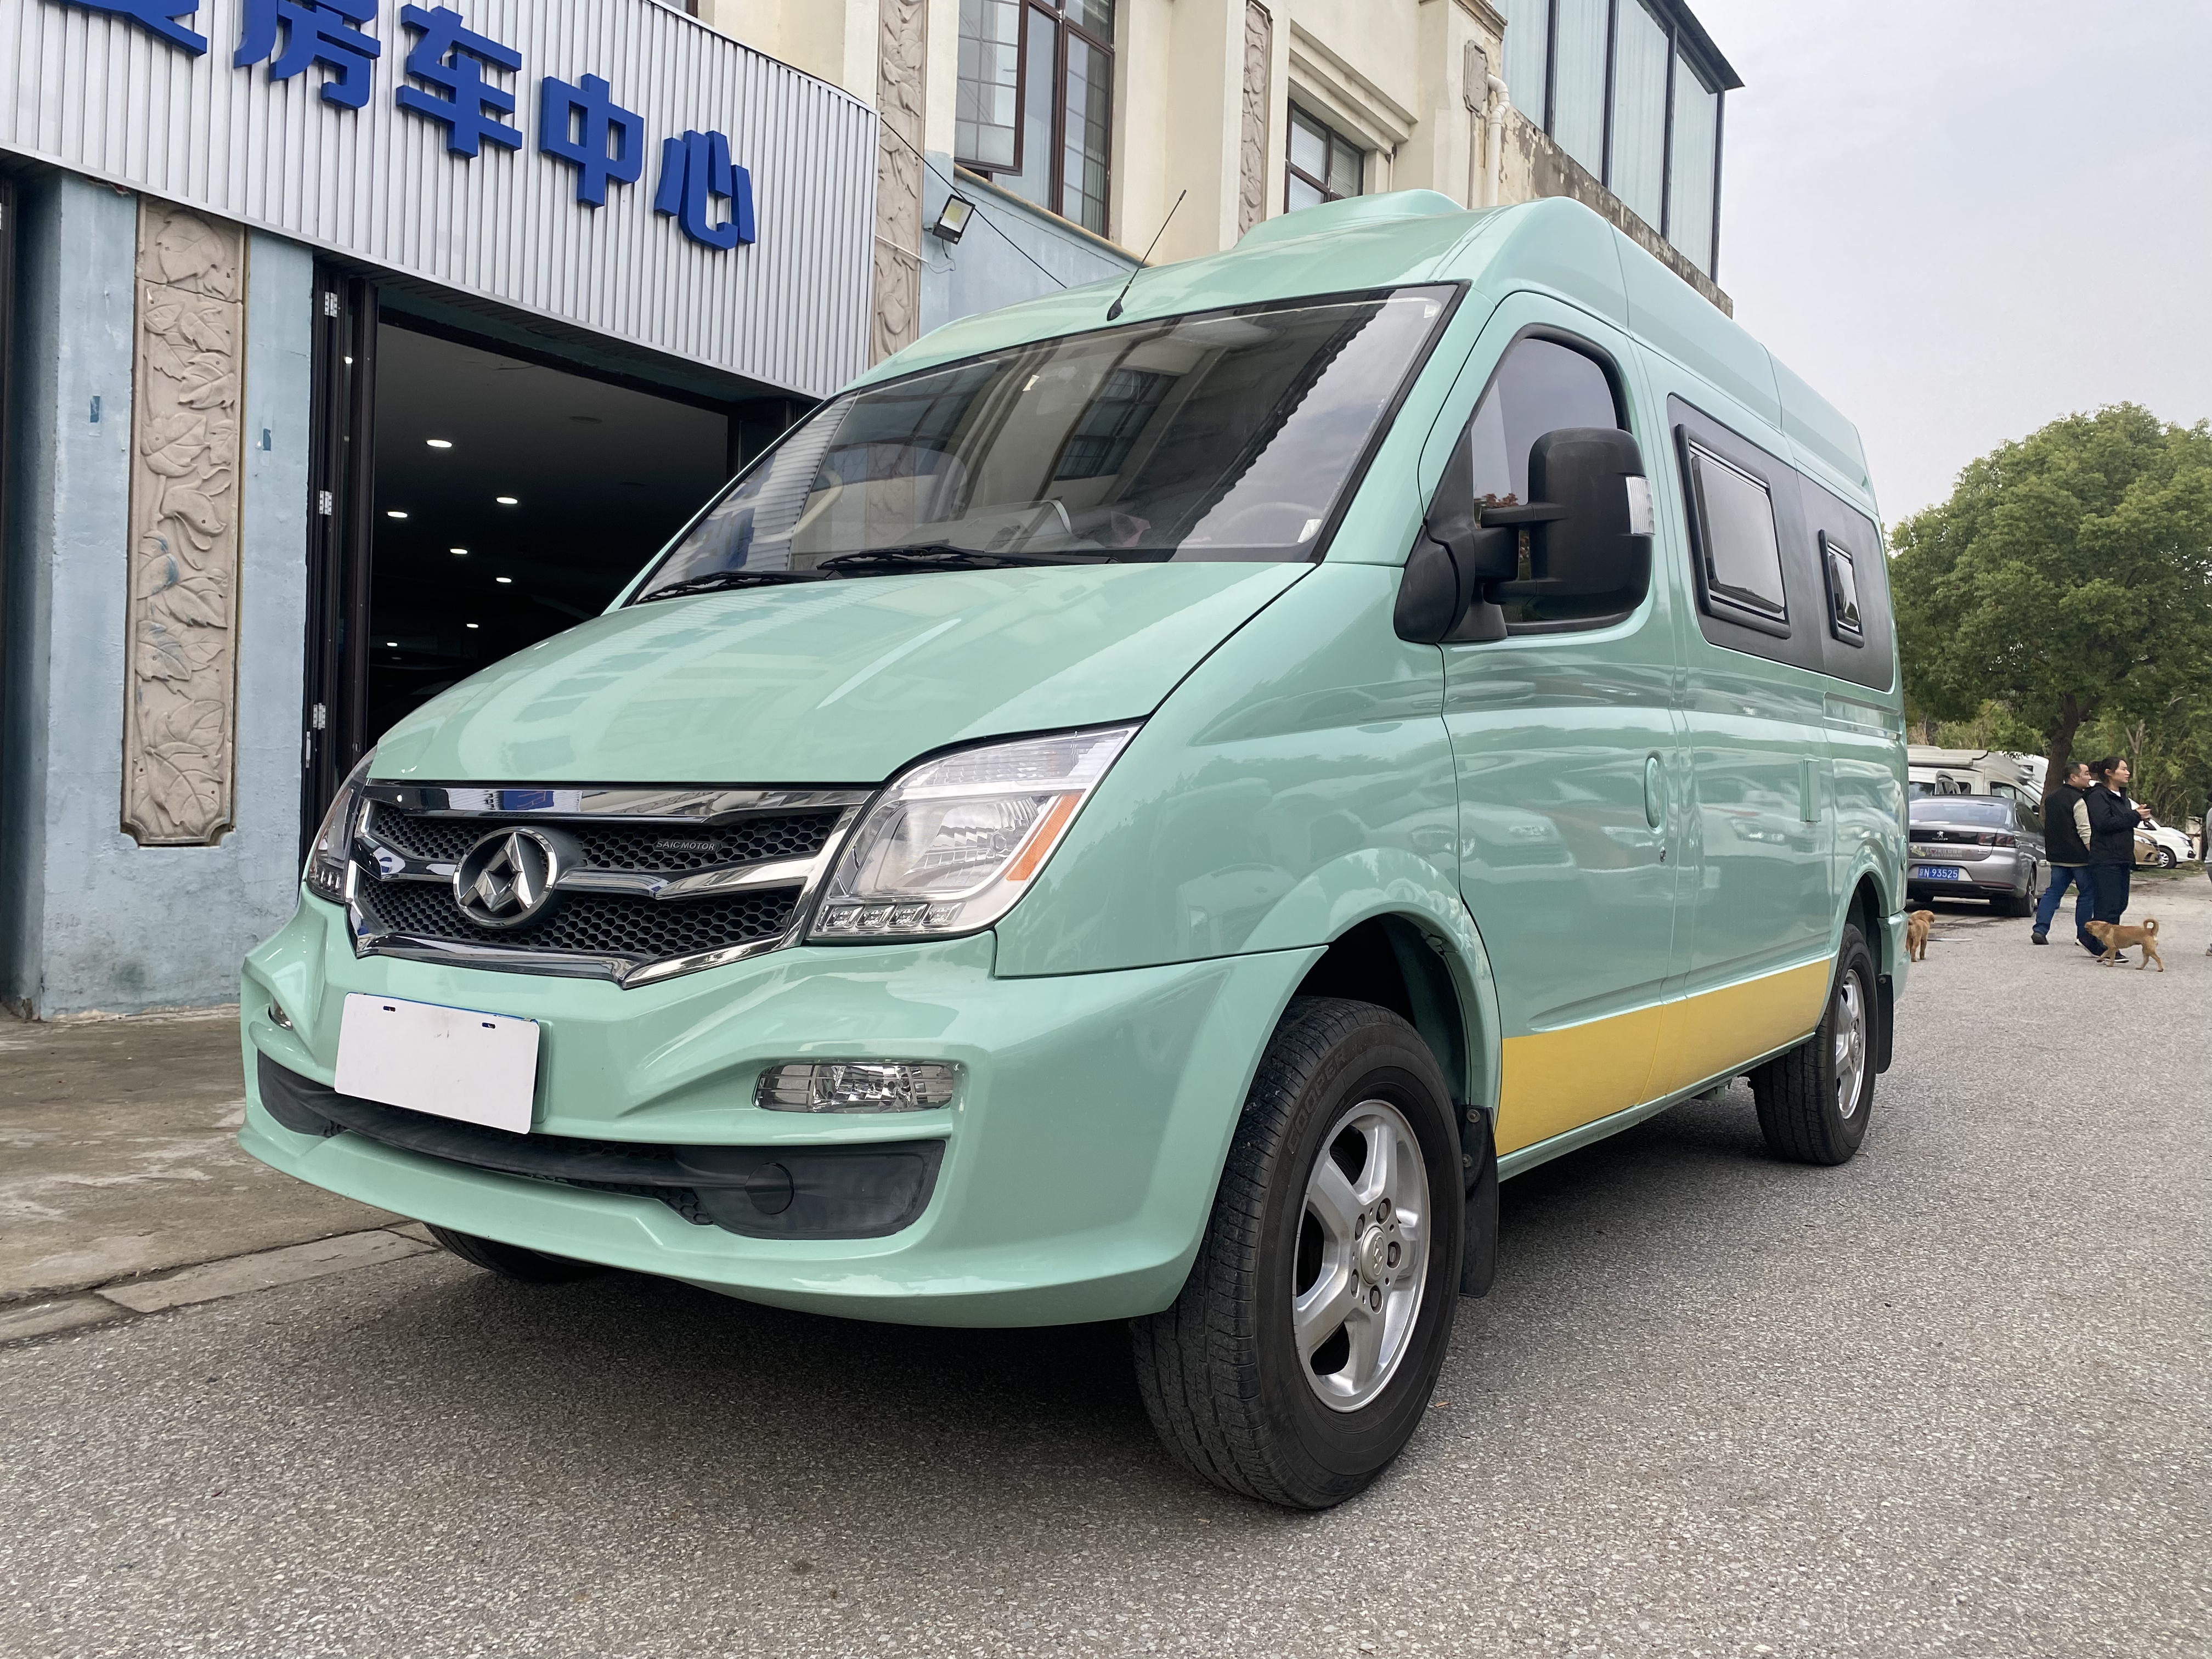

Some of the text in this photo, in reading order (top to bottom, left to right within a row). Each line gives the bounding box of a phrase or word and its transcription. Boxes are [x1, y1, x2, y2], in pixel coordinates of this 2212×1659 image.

[656, 840, 715, 851] SAIC MOTOR
[1287, 1048, 1346, 1154] COOPER
